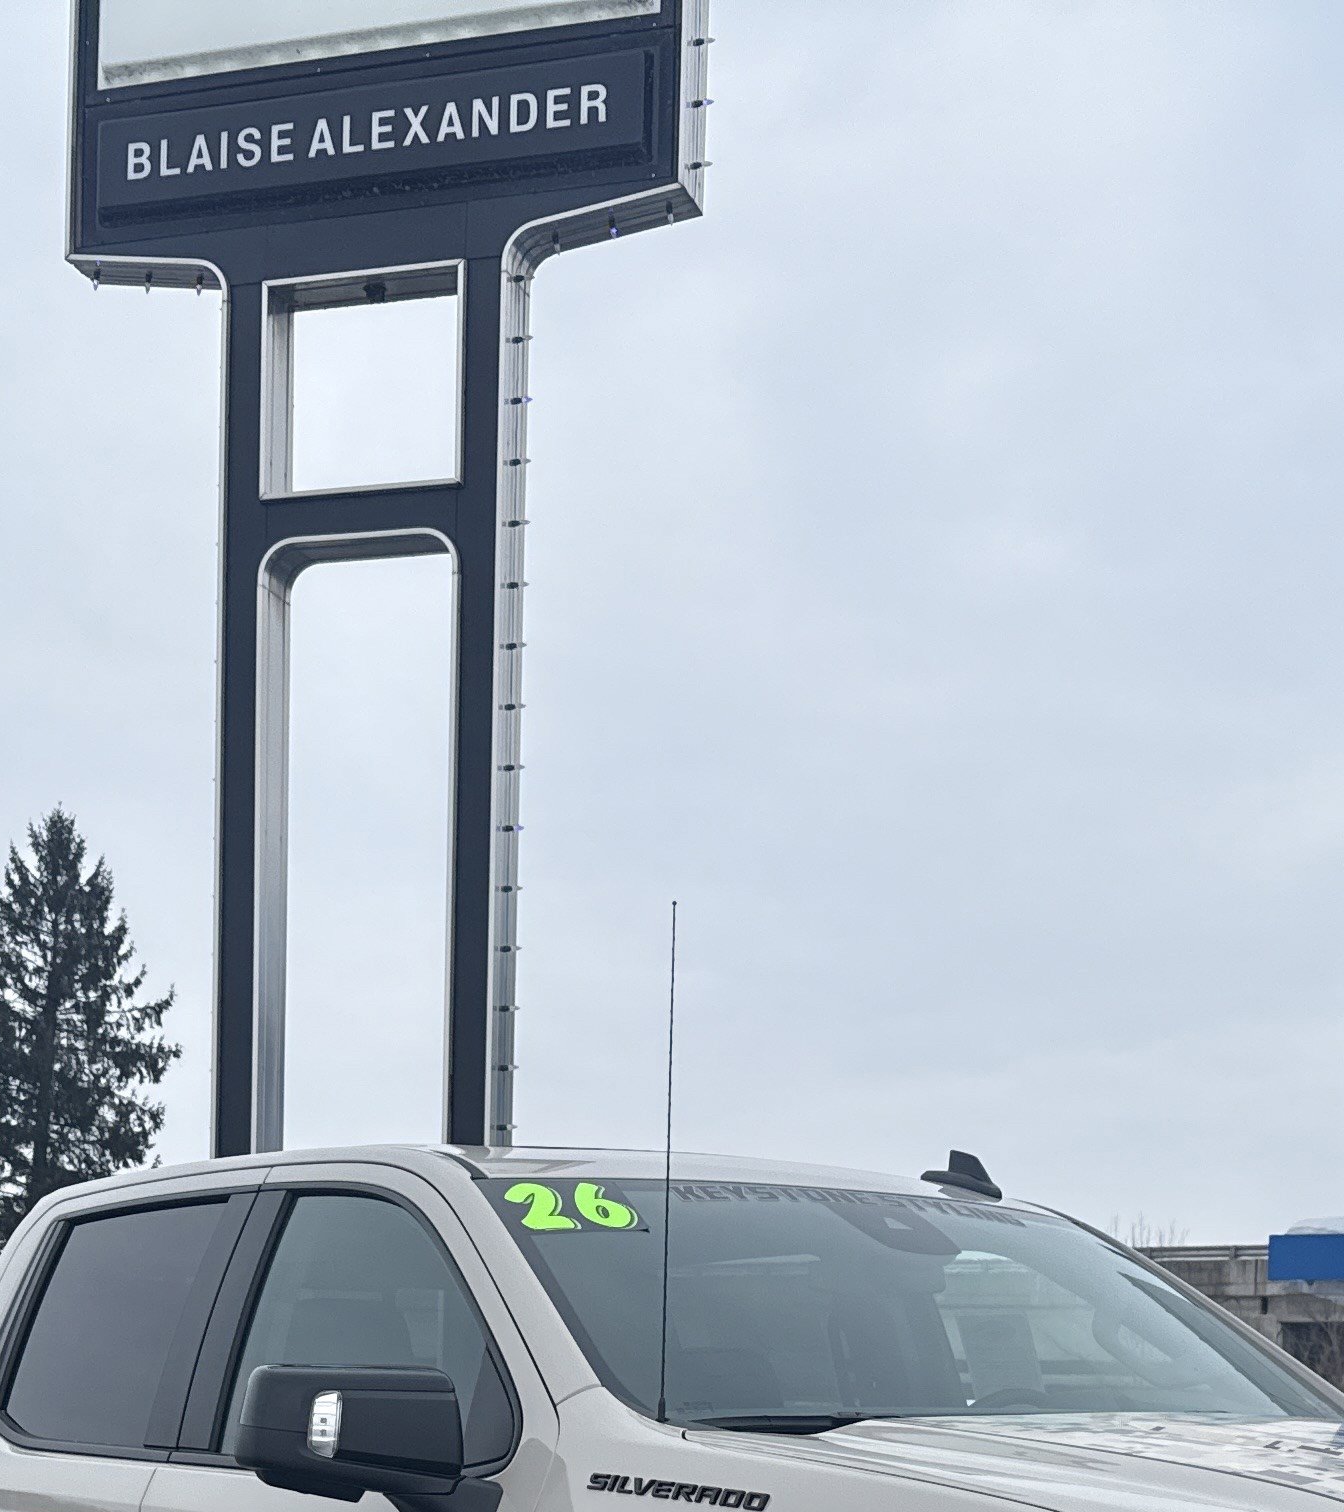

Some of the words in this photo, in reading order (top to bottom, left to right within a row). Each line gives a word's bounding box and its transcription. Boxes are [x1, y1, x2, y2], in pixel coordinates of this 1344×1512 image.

[126, 122, 295, 181] BLAISE
[307, 83, 609, 160] ALEXANDER
[504, 1182, 638, 1231] 26
[669, 1184, 879, 1208] KEYSTONE
[586, 1472, 771, 1512] SILVERADO
